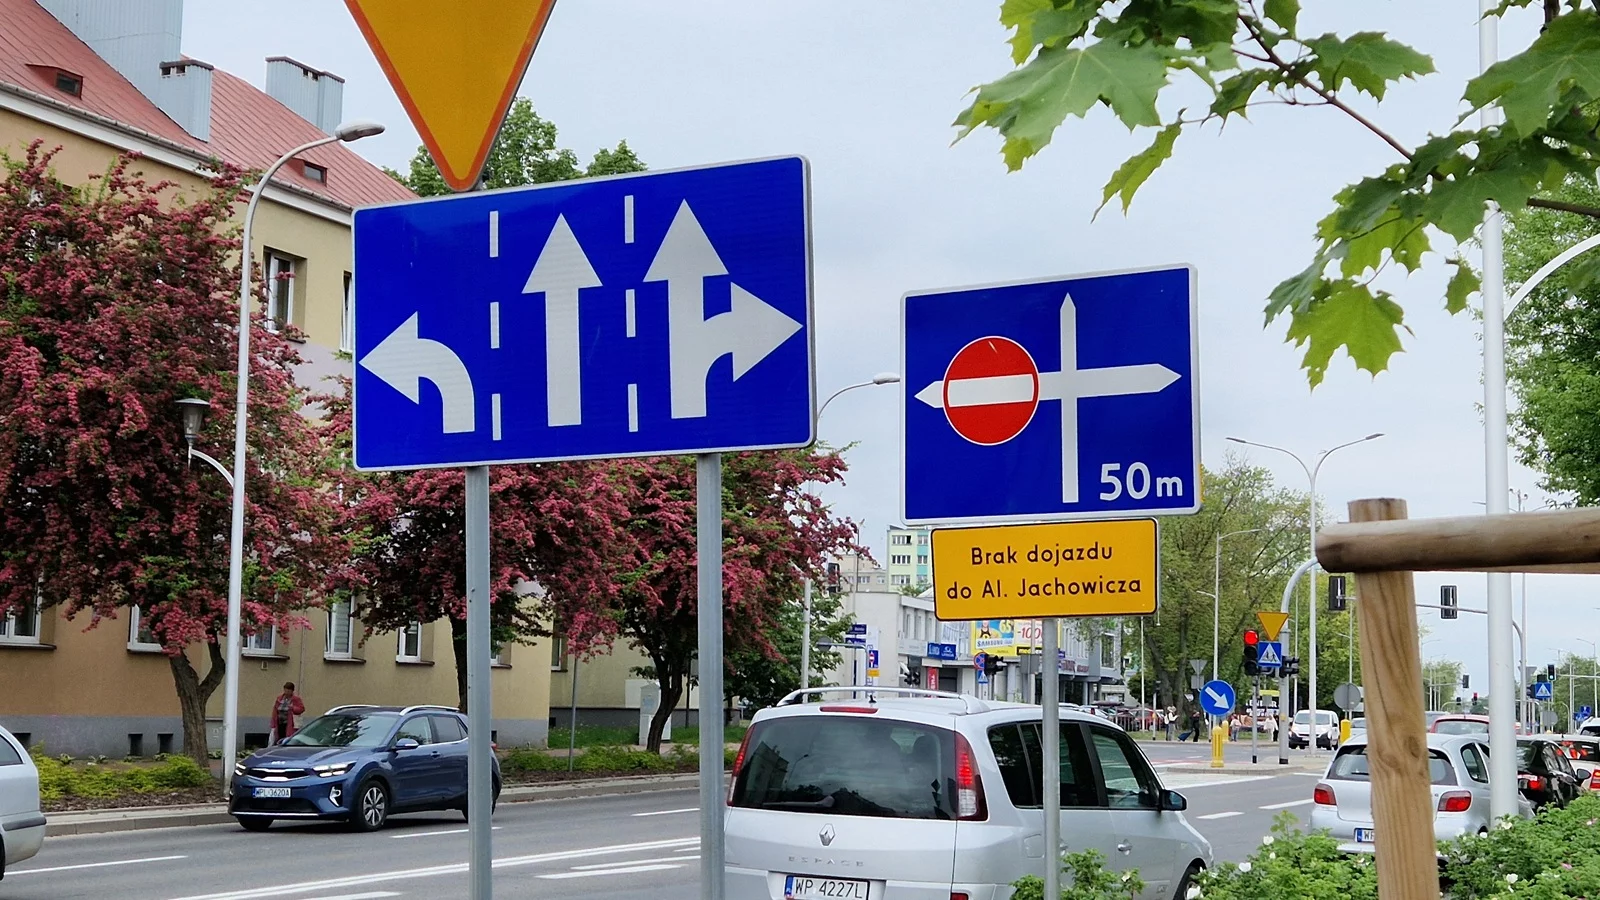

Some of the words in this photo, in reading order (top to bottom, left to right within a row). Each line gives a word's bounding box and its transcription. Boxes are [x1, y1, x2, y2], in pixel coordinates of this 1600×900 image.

[971, 546, 1017, 565] Brak
[1027, 542, 1113, 566] dojazdu
[947, 582, 972, 599] do
[982, 580, 1007, 598] Al.
[1018, 575, 1141, 597] Jachowicza
[788, 856, 864, 867] ESPACE
[795, 879, 814, 895] WP
[818, 881, 863, 899] 4227L
